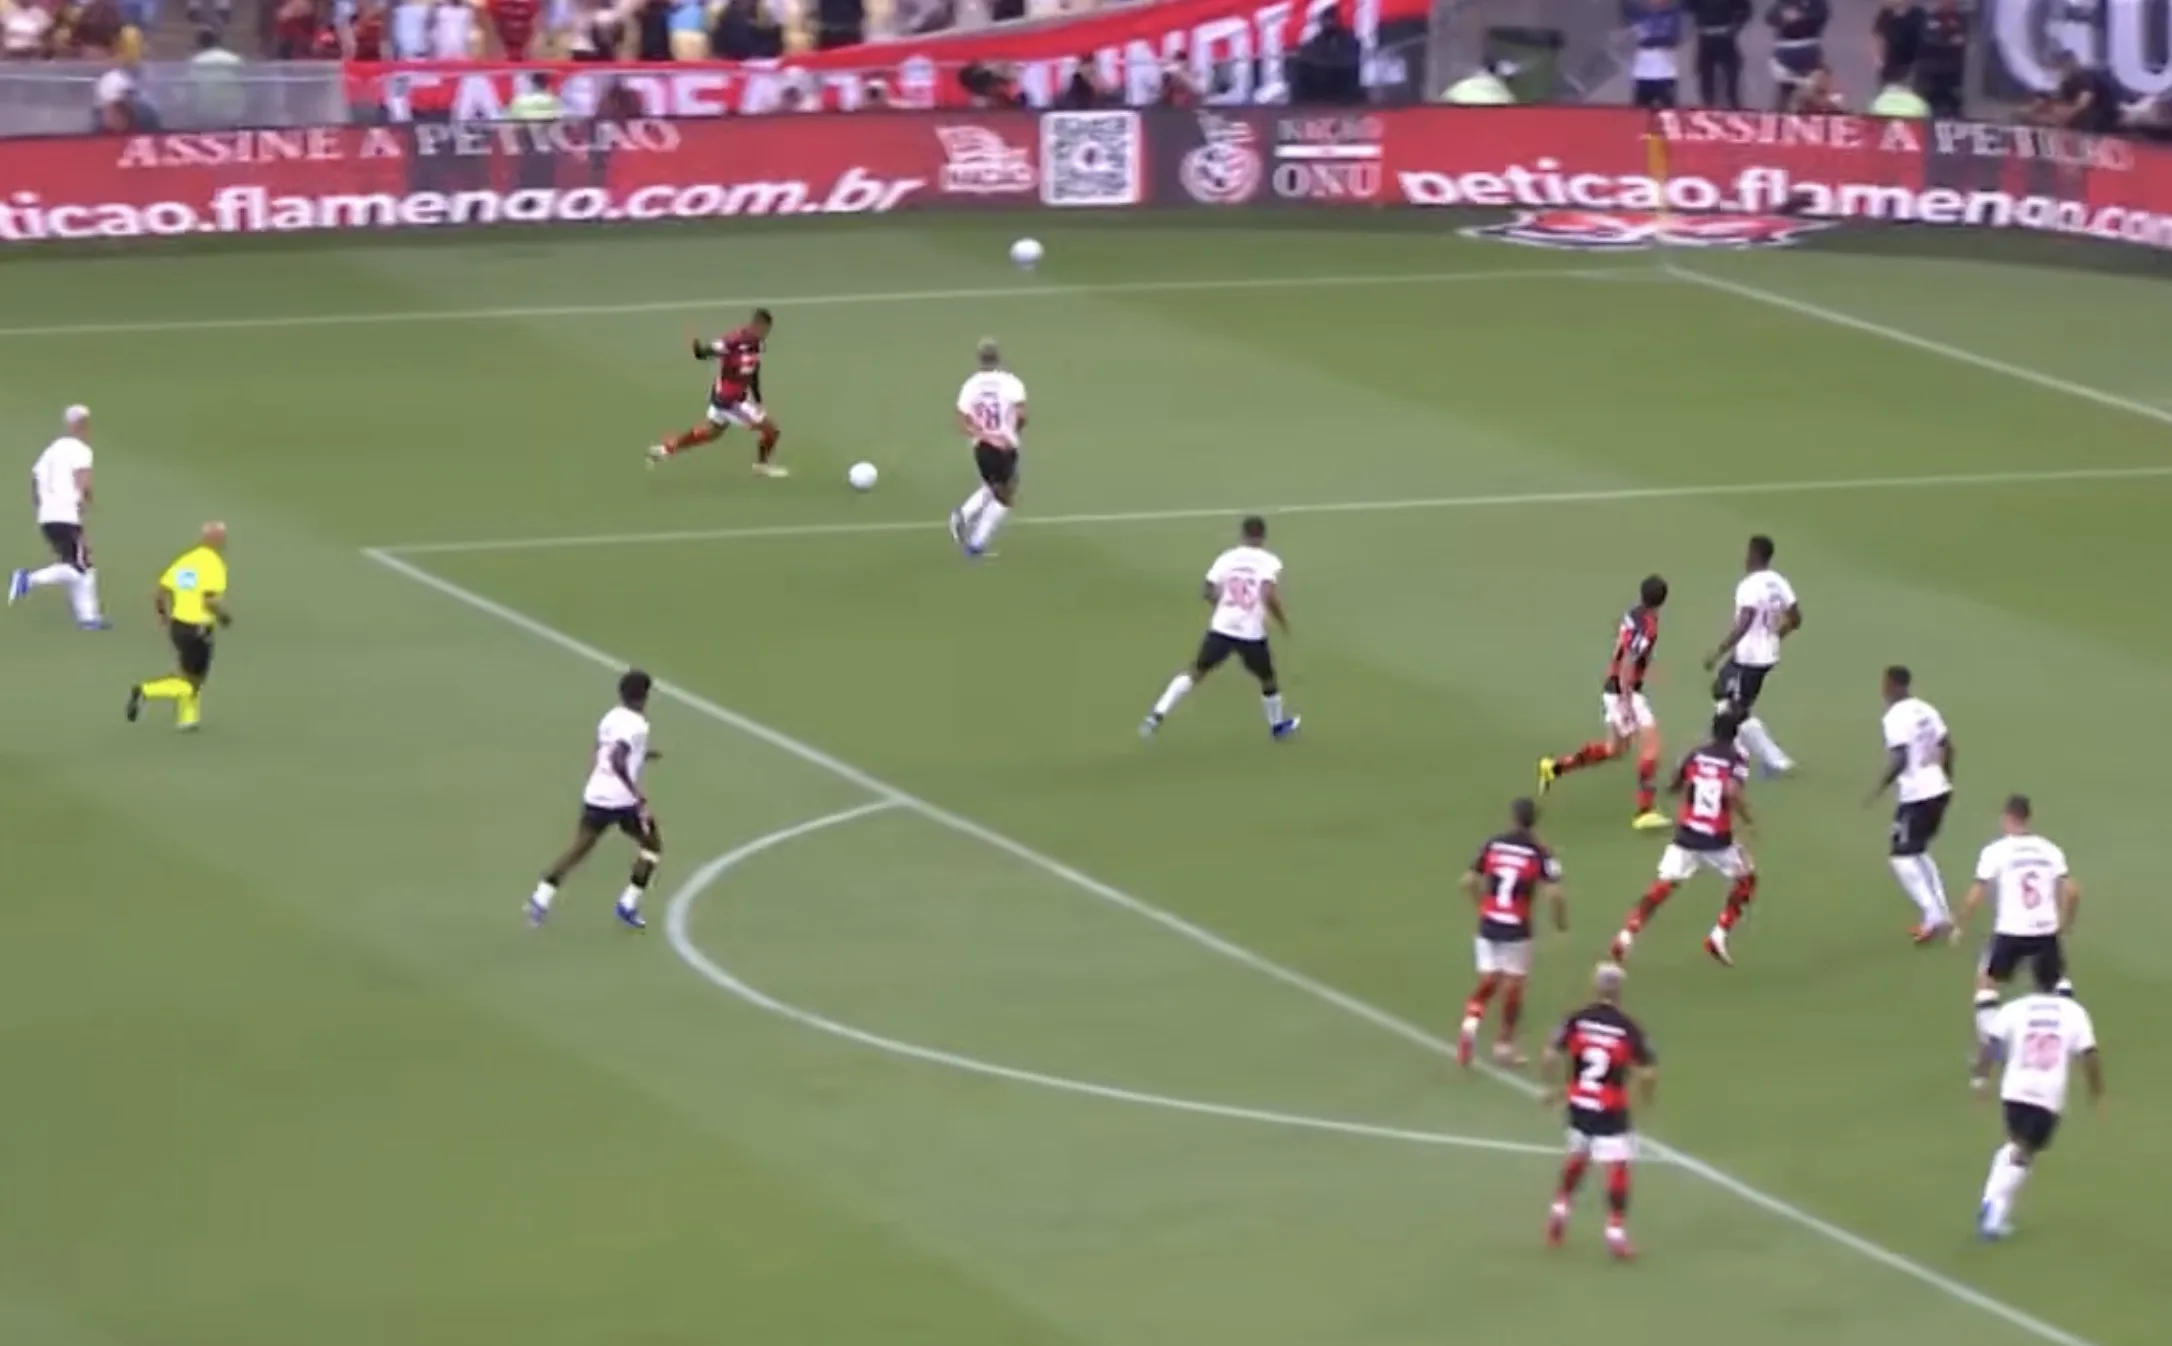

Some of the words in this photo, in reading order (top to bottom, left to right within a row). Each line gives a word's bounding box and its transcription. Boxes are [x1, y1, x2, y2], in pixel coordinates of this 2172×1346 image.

[117, 126, 344, 168] ASSINE
[359, 126, 402, 159] A
[1879, 119, 1921, 152] A
[1491, 866, 1518, 909] 7
[1579, 1045, 1611, 1093] 2
